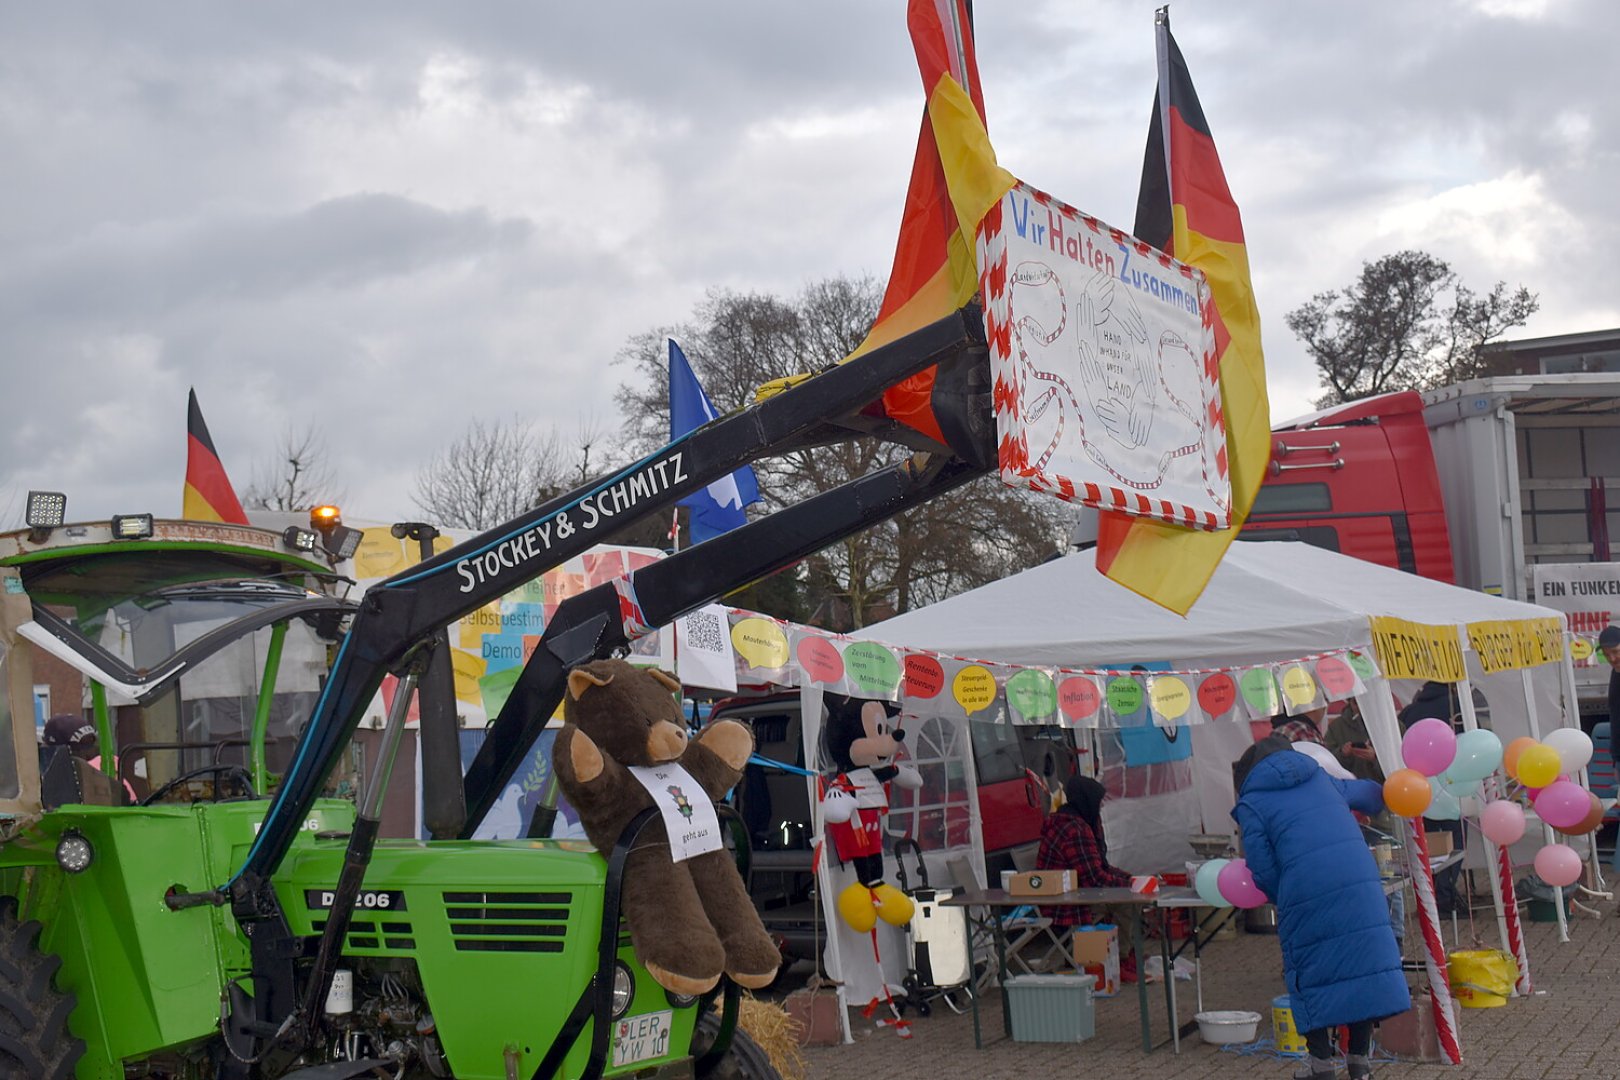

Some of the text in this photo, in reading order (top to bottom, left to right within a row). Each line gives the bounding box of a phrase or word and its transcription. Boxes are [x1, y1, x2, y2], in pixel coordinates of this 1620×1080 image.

[1009, 189, 1198, 316] Wir Halten Zusammen
[1106, 375, 1132, 399] LAND
[457, 451, 689, 594] STOCKEY & SCHMITZ
[1542, 581, 1566, 597] EIN
[851, 647, 886, 664] Zerstörung
[1373, 631, 1465, 679] INFORMATION
[1063, 691, 1094, 704] Inflation
[321, 891, 390, 908] D206
[629, 1016, 660, 1041] LER
[621, 1039, 645, 1063] YW
